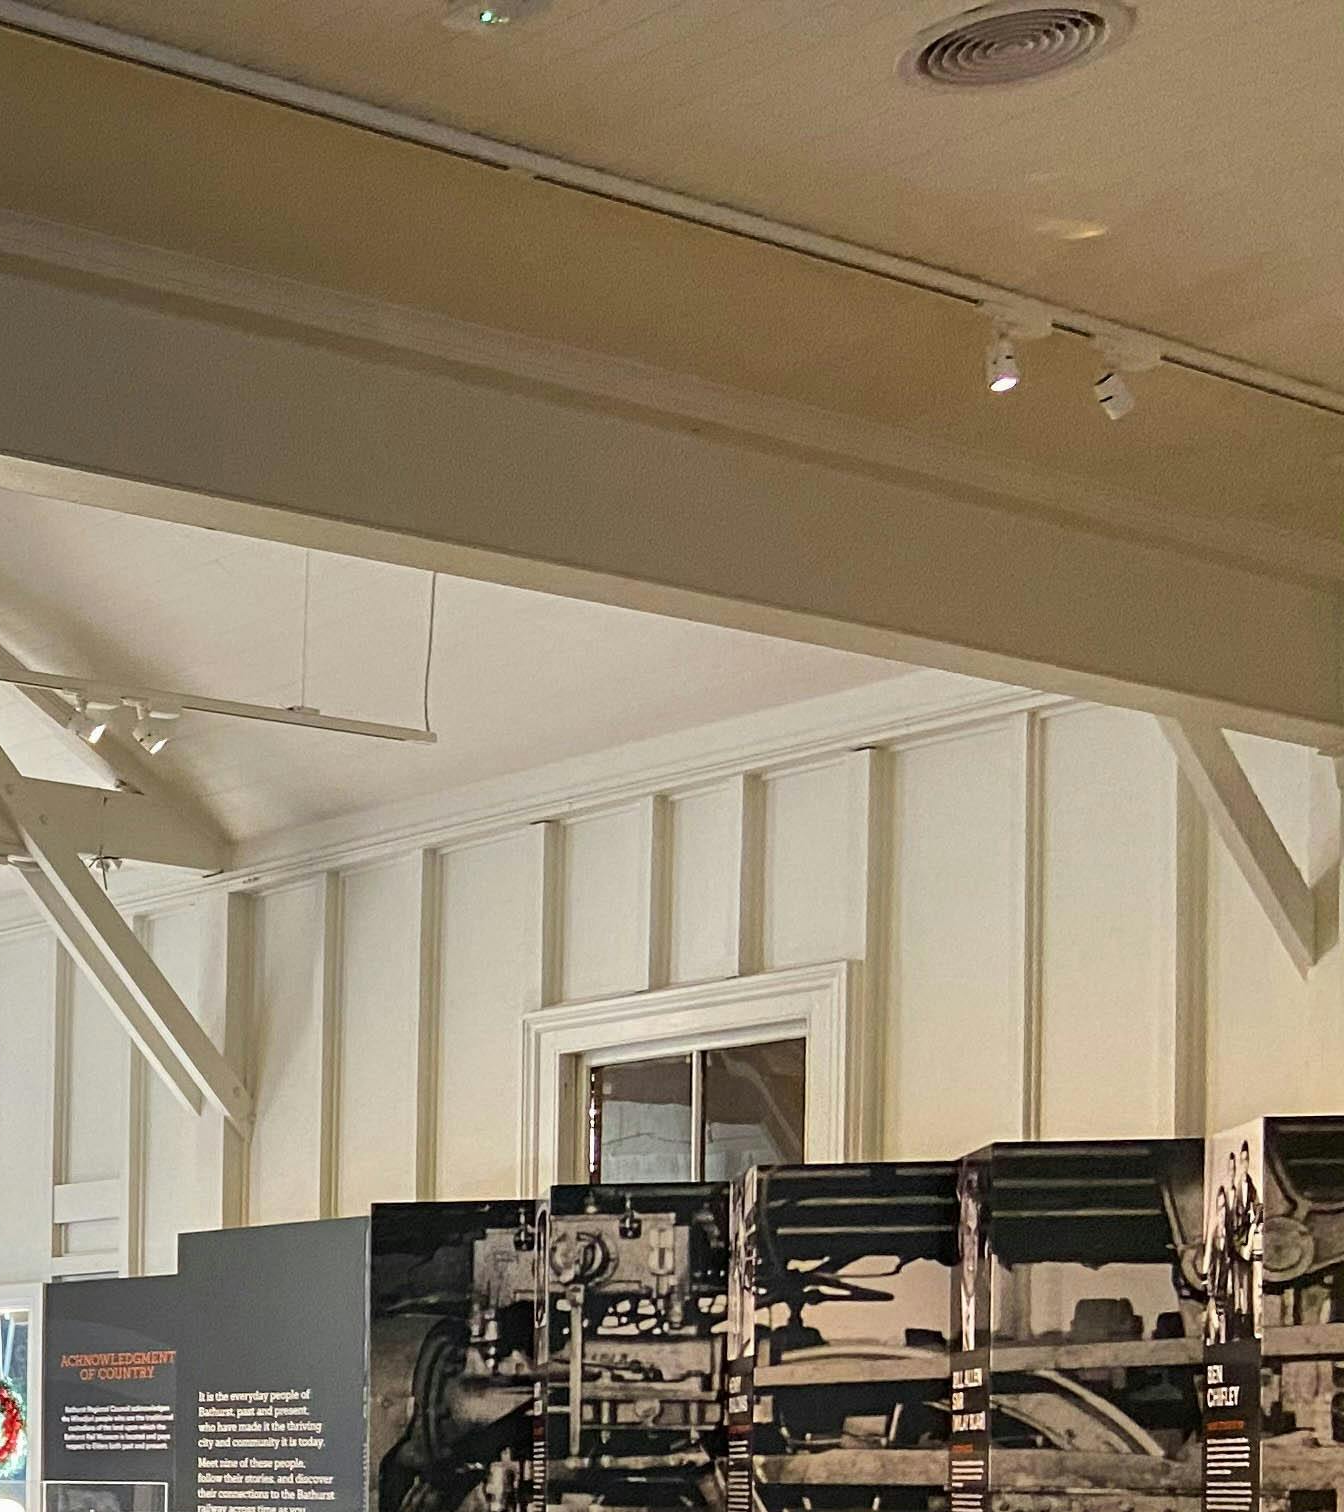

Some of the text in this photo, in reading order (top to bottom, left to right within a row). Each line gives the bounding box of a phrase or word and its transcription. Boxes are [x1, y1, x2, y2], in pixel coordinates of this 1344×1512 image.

[61, 1351, 176, 1367] ACKNOWLEDGMENT
[80, 1367, 154, 1380] OF COUNTRY
[207, 1392, 214, 1401] is
[215, 1391, 228, 1401] the
[230, 1391, 268, 1403] everyday
[270, 1390, 299, 1402] people
[300, 1389, 311, 1399] of
[237, 1407, 255, 1418] past
[257, 1406, 273, 1416] and
[198, 1421, 322, 1433] who have made it the thriving
[198, 1438, 214, 1449] city
[215, 1437, 230, 1447] and
[232, 1438, 280, 1449] community
[281, 1438, 288, 1446] it
[289, 1438, 296, 1446] is
[198, 1457, 218, 1468] Meet
[239, 1458, 248, 1468] of
[250, 1458, 272, 1468] these
[198, 1473, 222, 1483] follow
[224, 1474, 244, 1483] their
[277, 1474, 294, 1483] and
[295, 1474, 334, 1484] discover
[198, 1489, 217, 1498] their
[271, 1490, 280, 1498] to
[281, 1489, 295, 1499] the
[297, 1489, 335, 1500] Bathurst
